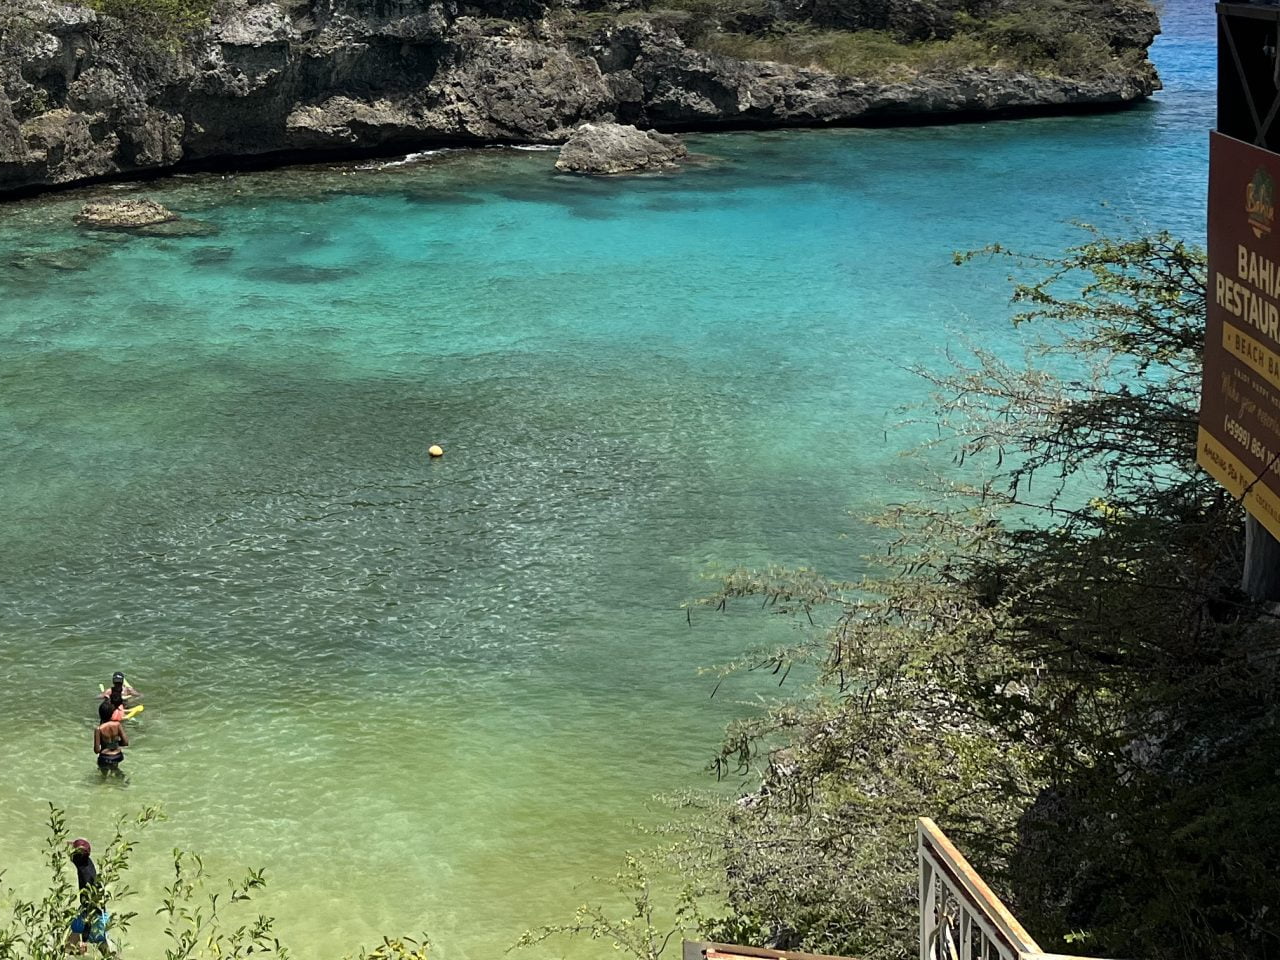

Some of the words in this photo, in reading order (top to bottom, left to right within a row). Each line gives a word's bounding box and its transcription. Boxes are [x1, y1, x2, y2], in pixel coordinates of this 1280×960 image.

[1238, 244, 1280, 298] BAHIA
[1216, 272, 1280, 344] RESTAUR
[1235, 334, 1264, 368] BEACH
[1224, 414, 1250, 449] (+5999)
[1251, 437, 1265, 462] 864
